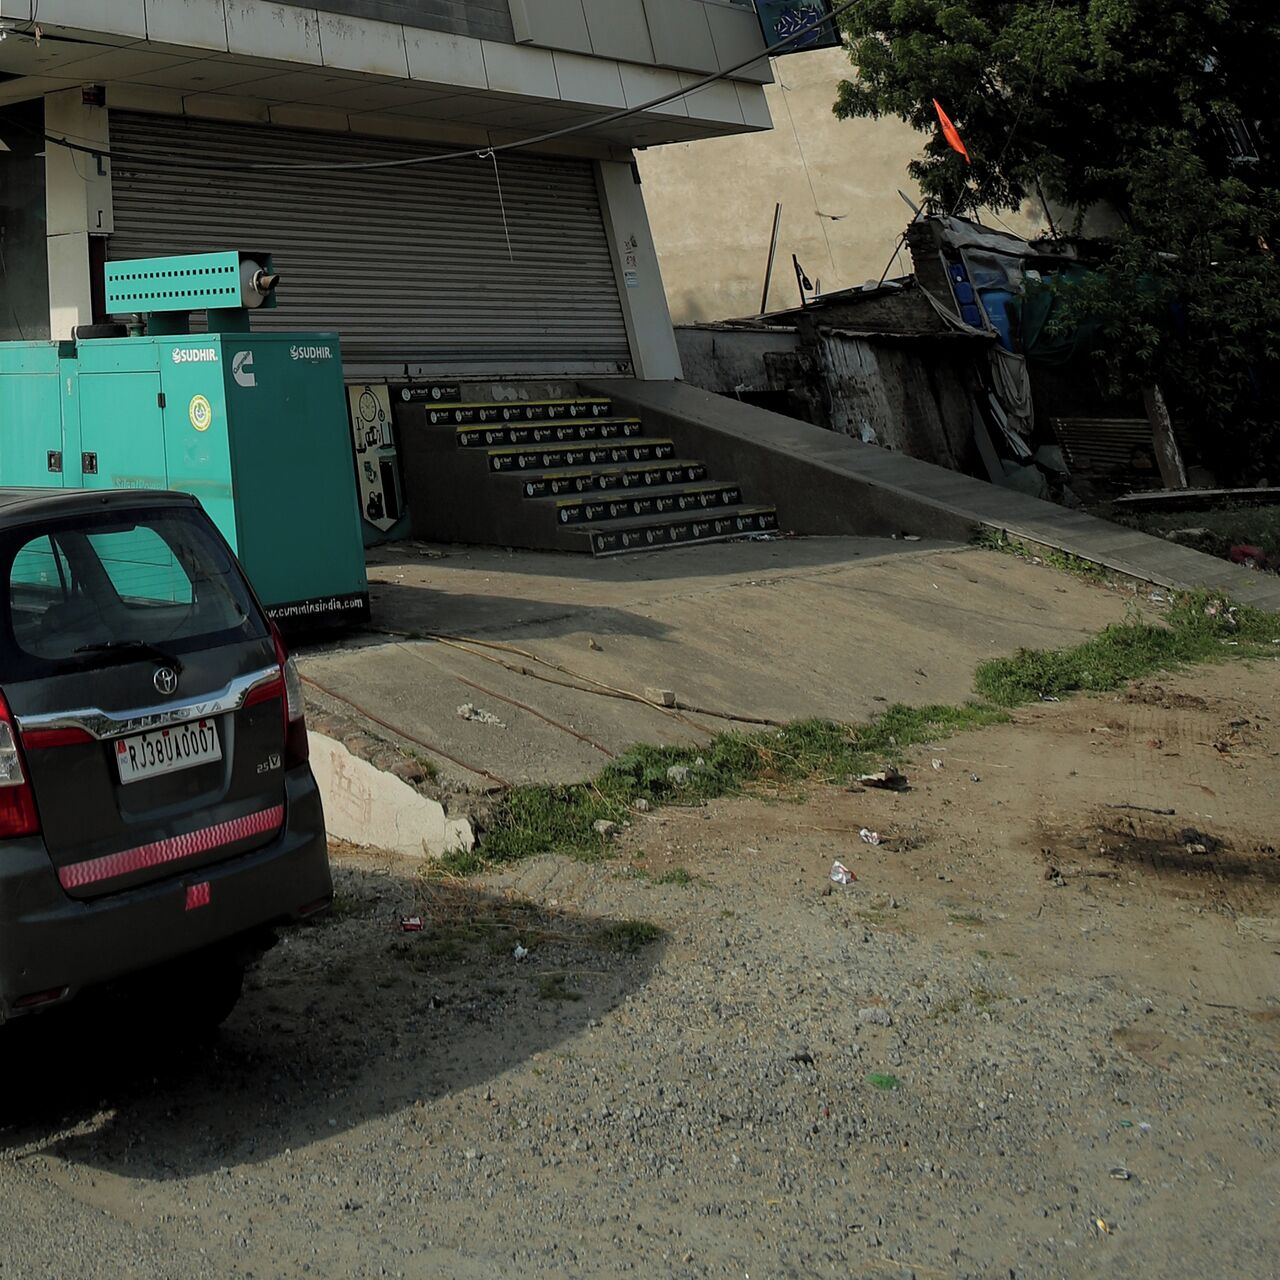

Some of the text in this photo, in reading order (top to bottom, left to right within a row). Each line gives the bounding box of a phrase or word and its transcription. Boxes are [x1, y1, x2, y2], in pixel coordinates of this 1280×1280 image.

[181, 348, 217, 362] SUDHIR
[298, 346, 332, 359] SUDHIR
[266, 598, 363, 618] w.cumminsindia.com
[128, 726, 216, 772] RJ38UA0007
